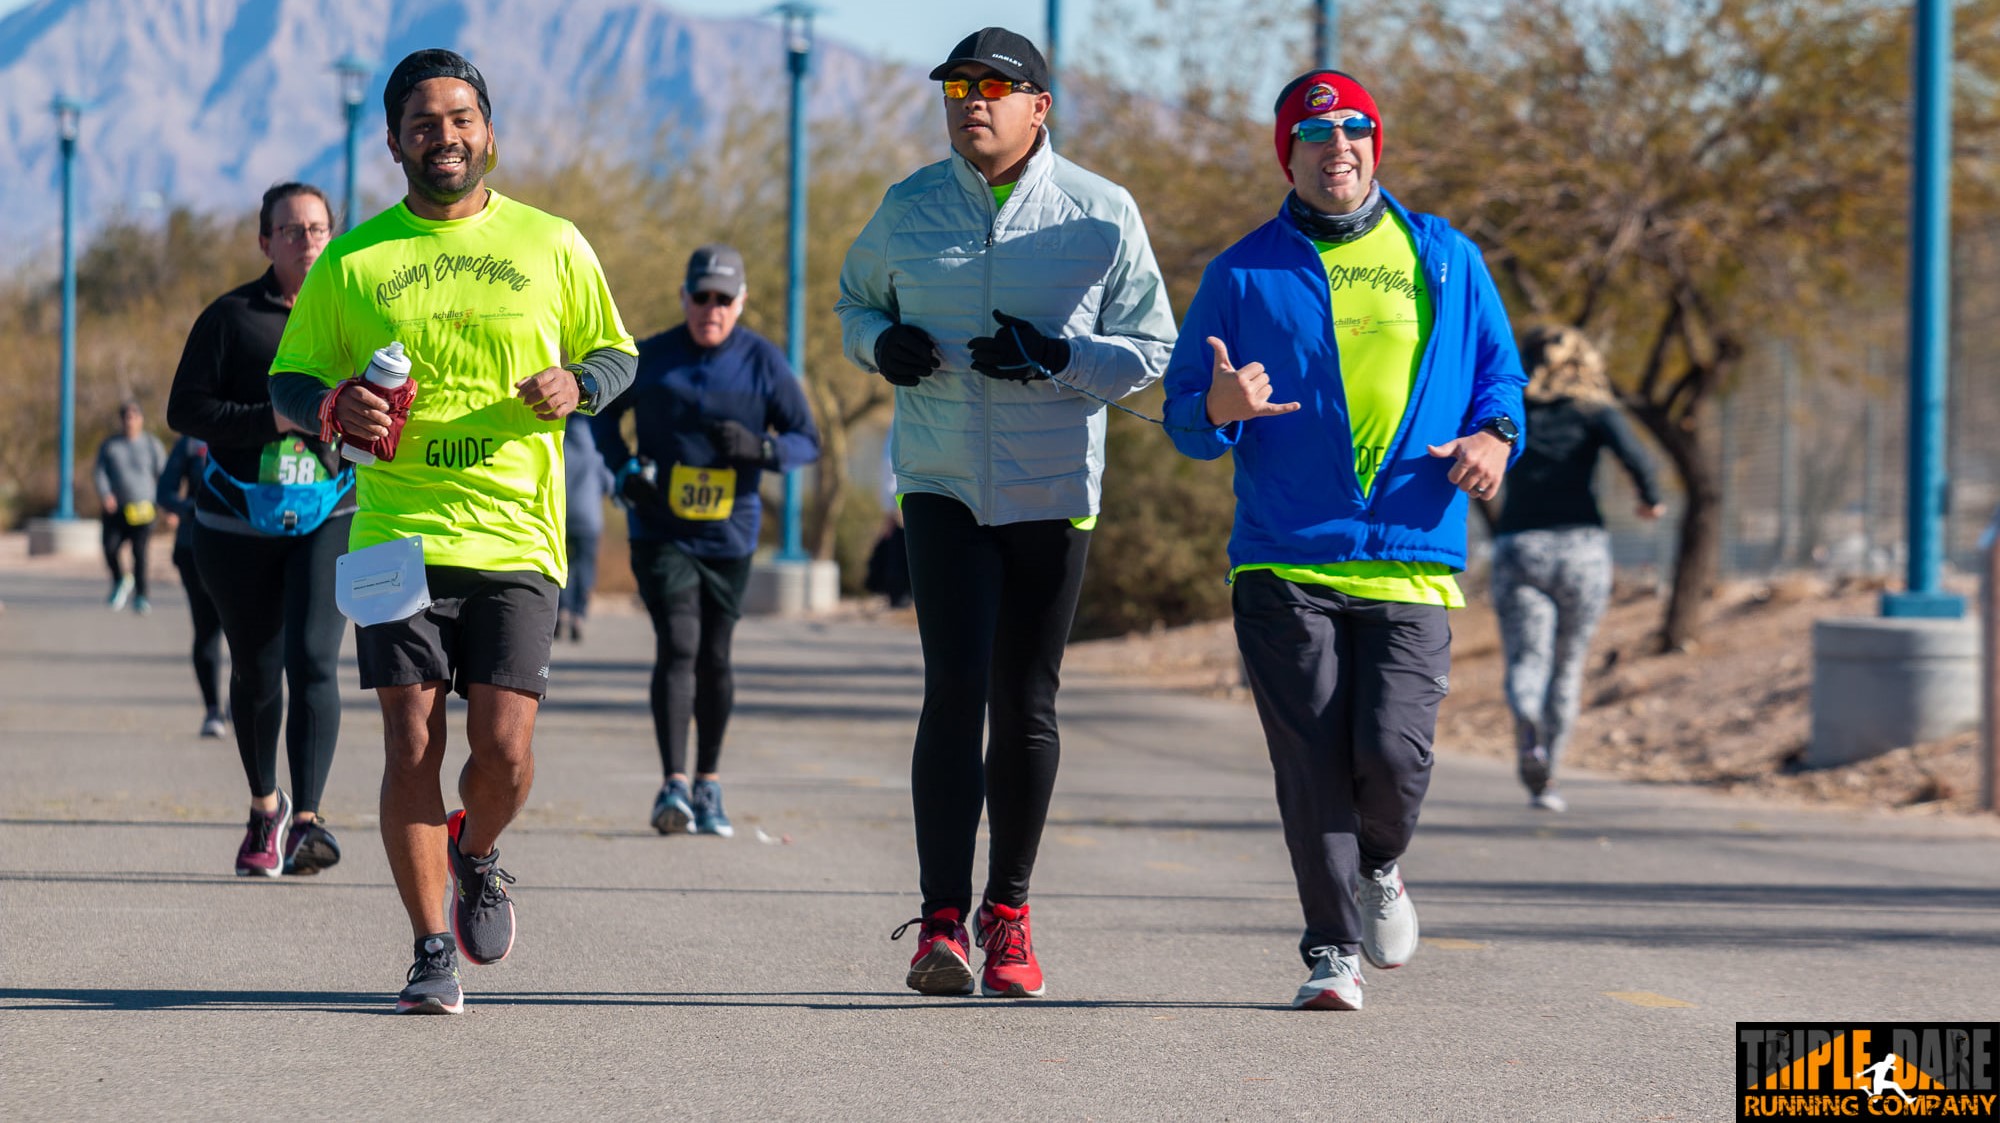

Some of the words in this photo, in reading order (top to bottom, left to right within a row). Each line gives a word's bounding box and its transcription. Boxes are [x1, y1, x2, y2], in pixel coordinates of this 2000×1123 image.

[992, 53, 1023, 67] OAKLEY
[376, 261, 430, 308] Raising
[434, 252, 532, 292] Expectations
[1329, 264, 1424, 300] Expectations
[431, 309, 465, 321] Achilles
[1334, 317, 1361, 327] chilles
[425, 436, 495, 468] GUIDE
[279, 455, 316, 485] 58
[680, 483, 724, 509] 307
